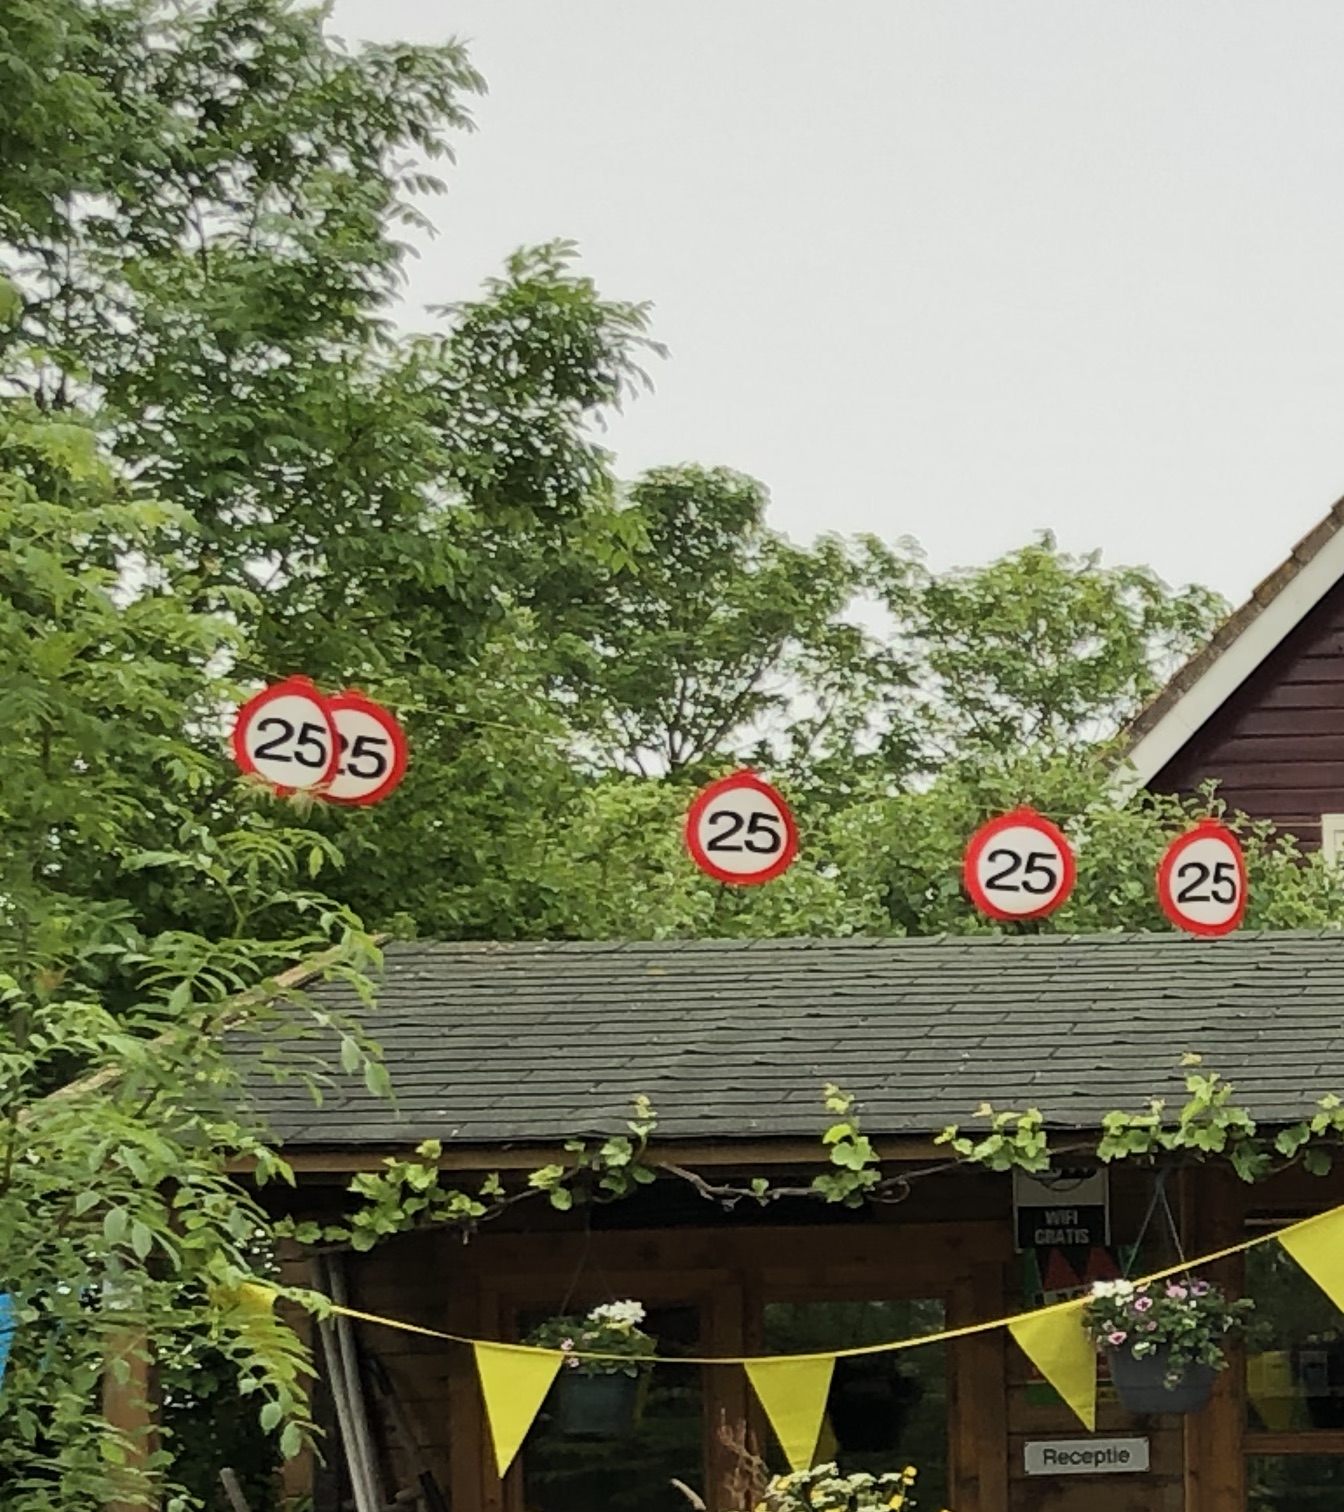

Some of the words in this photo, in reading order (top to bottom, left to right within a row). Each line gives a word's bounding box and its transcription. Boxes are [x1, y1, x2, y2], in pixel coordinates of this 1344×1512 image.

[254, 717, 327, 768] 25
[707, 810, 782, 853] 25
[986, 848, 1058, 894] 25
[1177, 862, 1238, 904] 25
[1035, 1228, 1090, 1245] GRATIS
[1045, 1209, 1078, 1225] WIFI
[1043, 1447, 1130, 1468] Receptie
